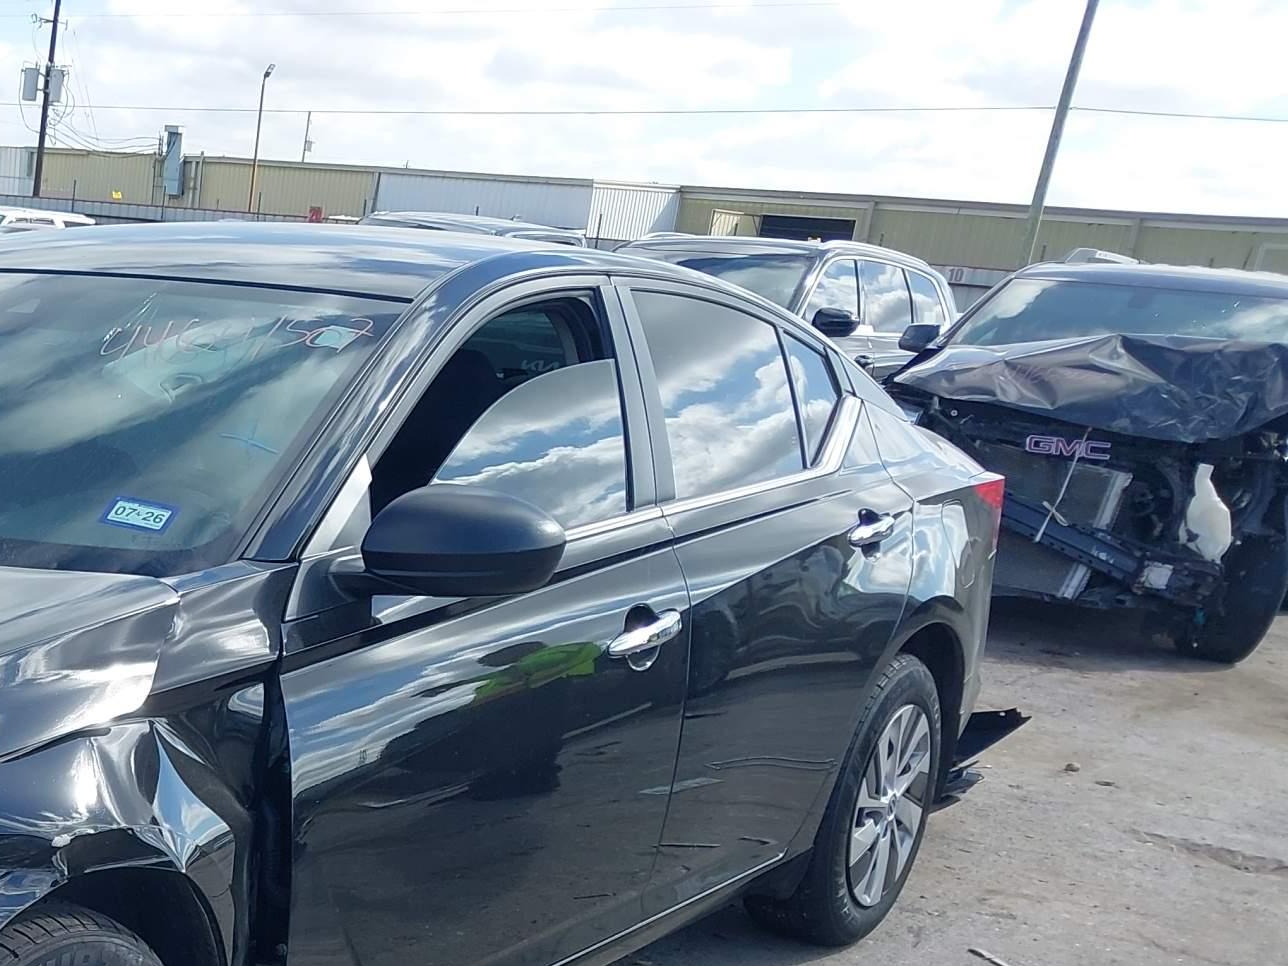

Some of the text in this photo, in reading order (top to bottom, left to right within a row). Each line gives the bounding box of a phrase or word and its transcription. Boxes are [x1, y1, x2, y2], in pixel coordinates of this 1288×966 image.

[948, 268, 964, 282] 10
[1025, 434, 1112, 461] GMC
[114, 505, 166, 525] 07 26
